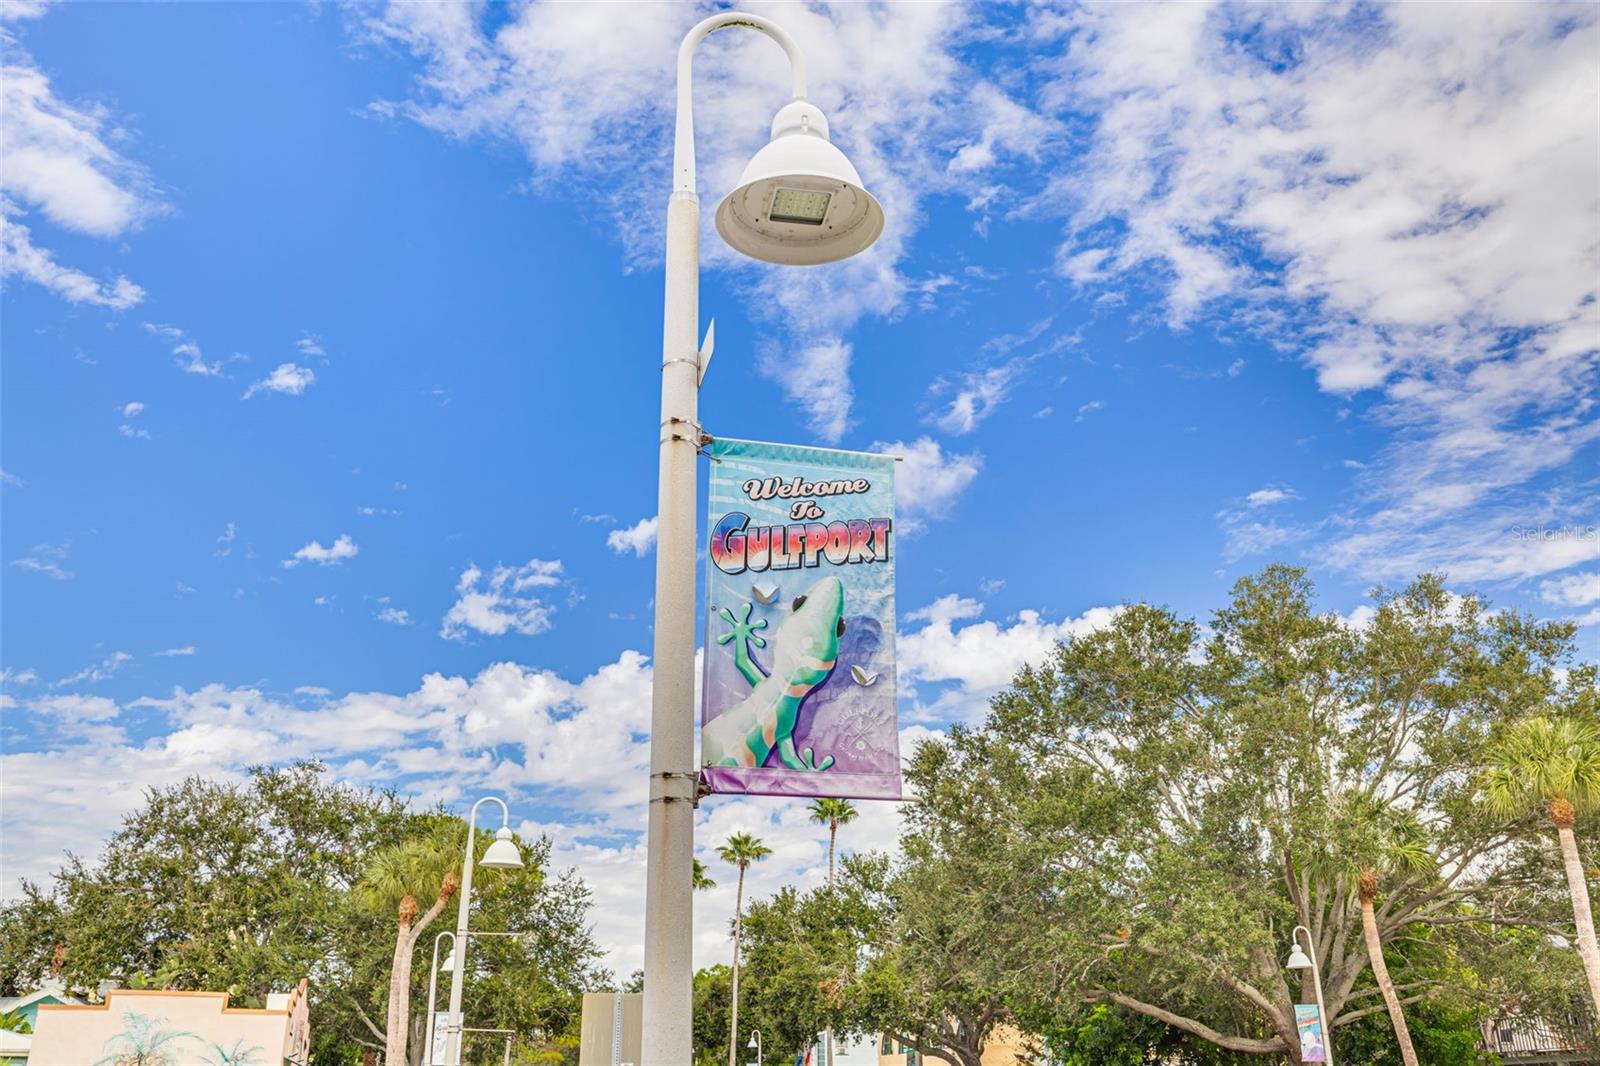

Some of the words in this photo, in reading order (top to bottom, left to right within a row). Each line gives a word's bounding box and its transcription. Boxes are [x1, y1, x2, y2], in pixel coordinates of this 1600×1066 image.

[743, 477, 870, 499] Welcome
[790, 500, 825, 520] To
[710, 512, 891, 575] GULFPORT
